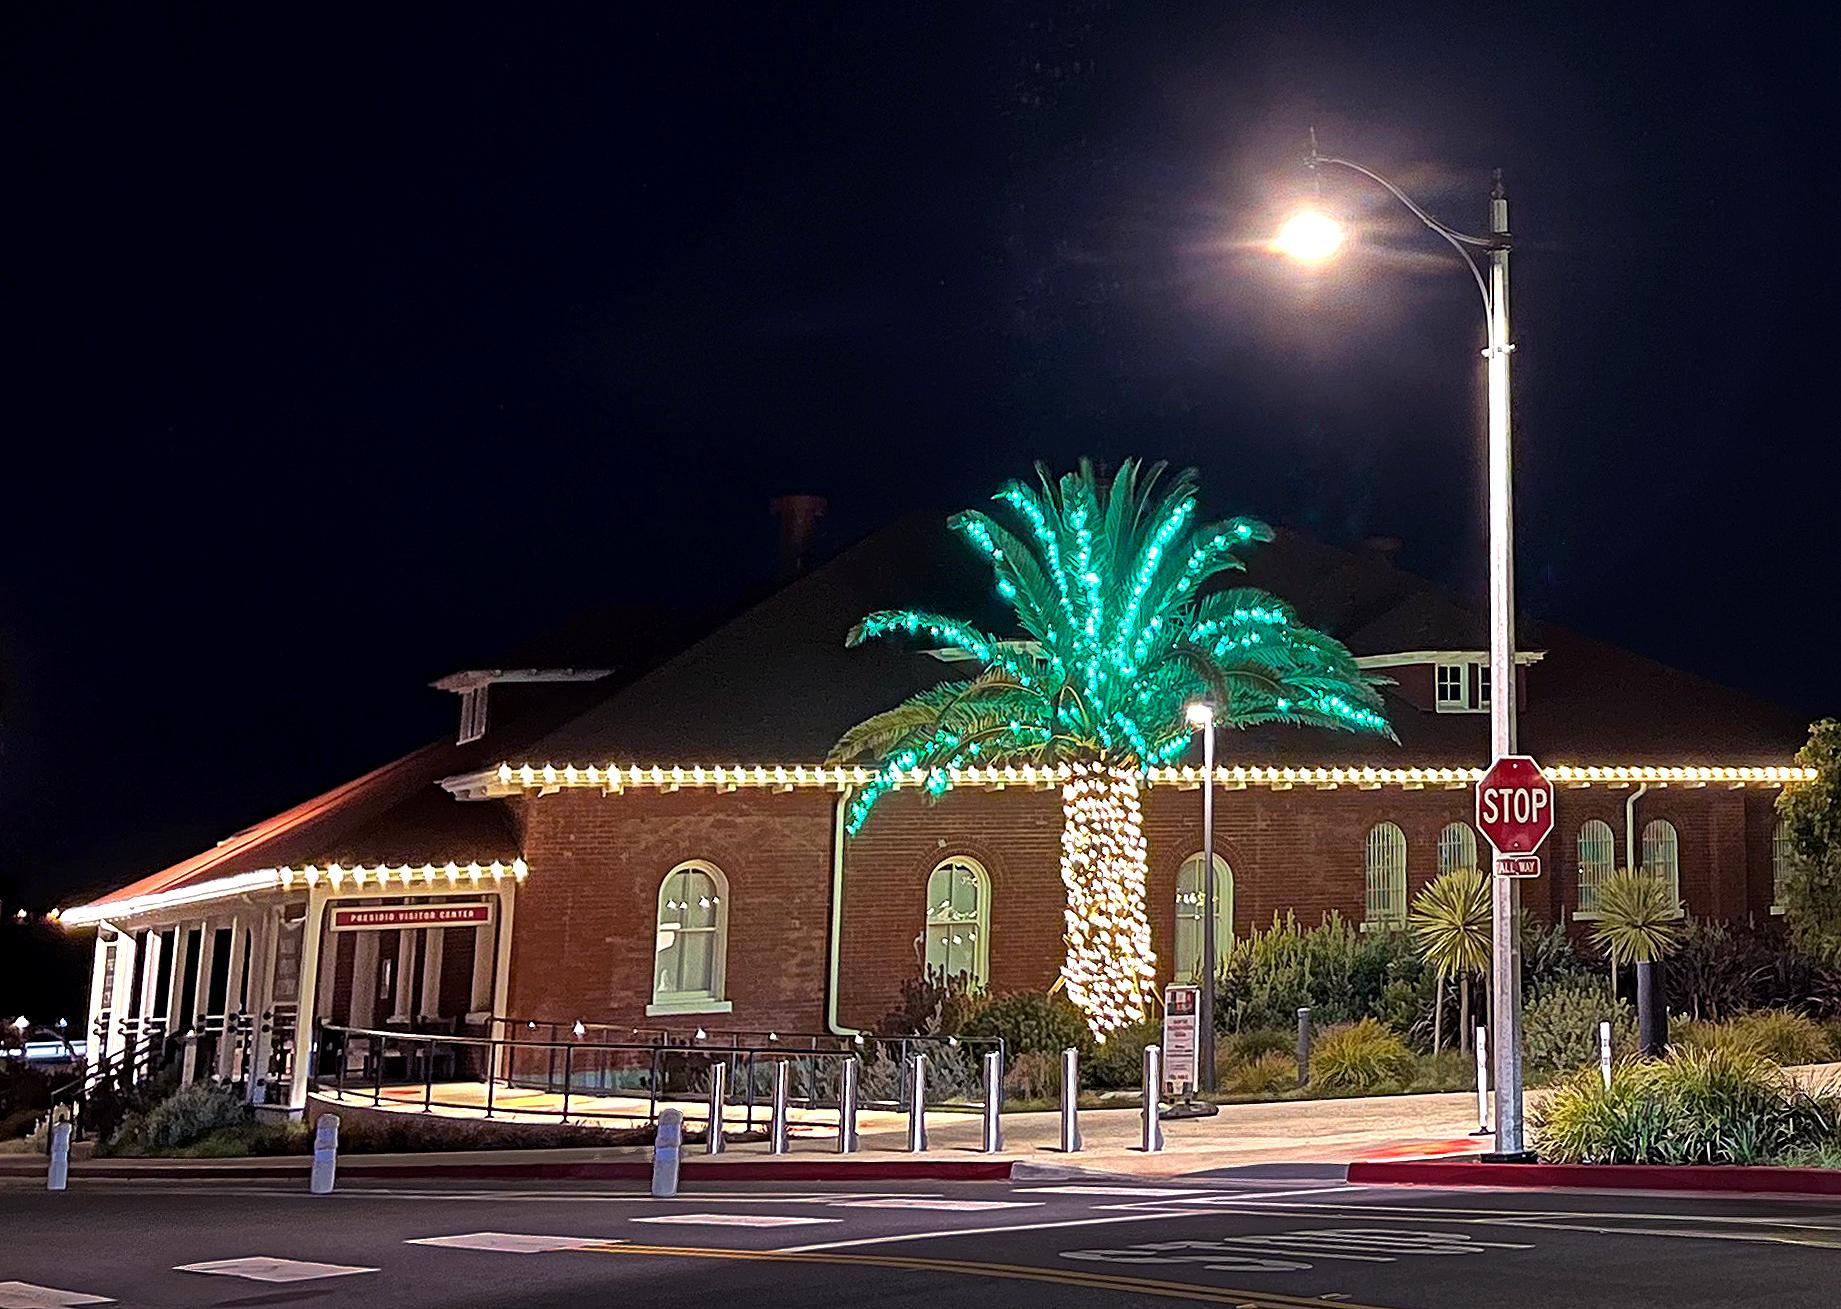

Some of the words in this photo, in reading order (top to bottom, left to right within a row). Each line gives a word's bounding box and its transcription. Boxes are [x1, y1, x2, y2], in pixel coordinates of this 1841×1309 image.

[1482, 787, 1548, 824] STOP
[1498, 861, 1516, 874] ALL
[1518, 861, 1535, 873] WAY
[350, 913, 394, 922] PRESIDIO
[398, 911, 435, 920] VISITOR
[439, 910, 474, 919] CENTER
[1058, 1228, 1536, 1272] STOP
